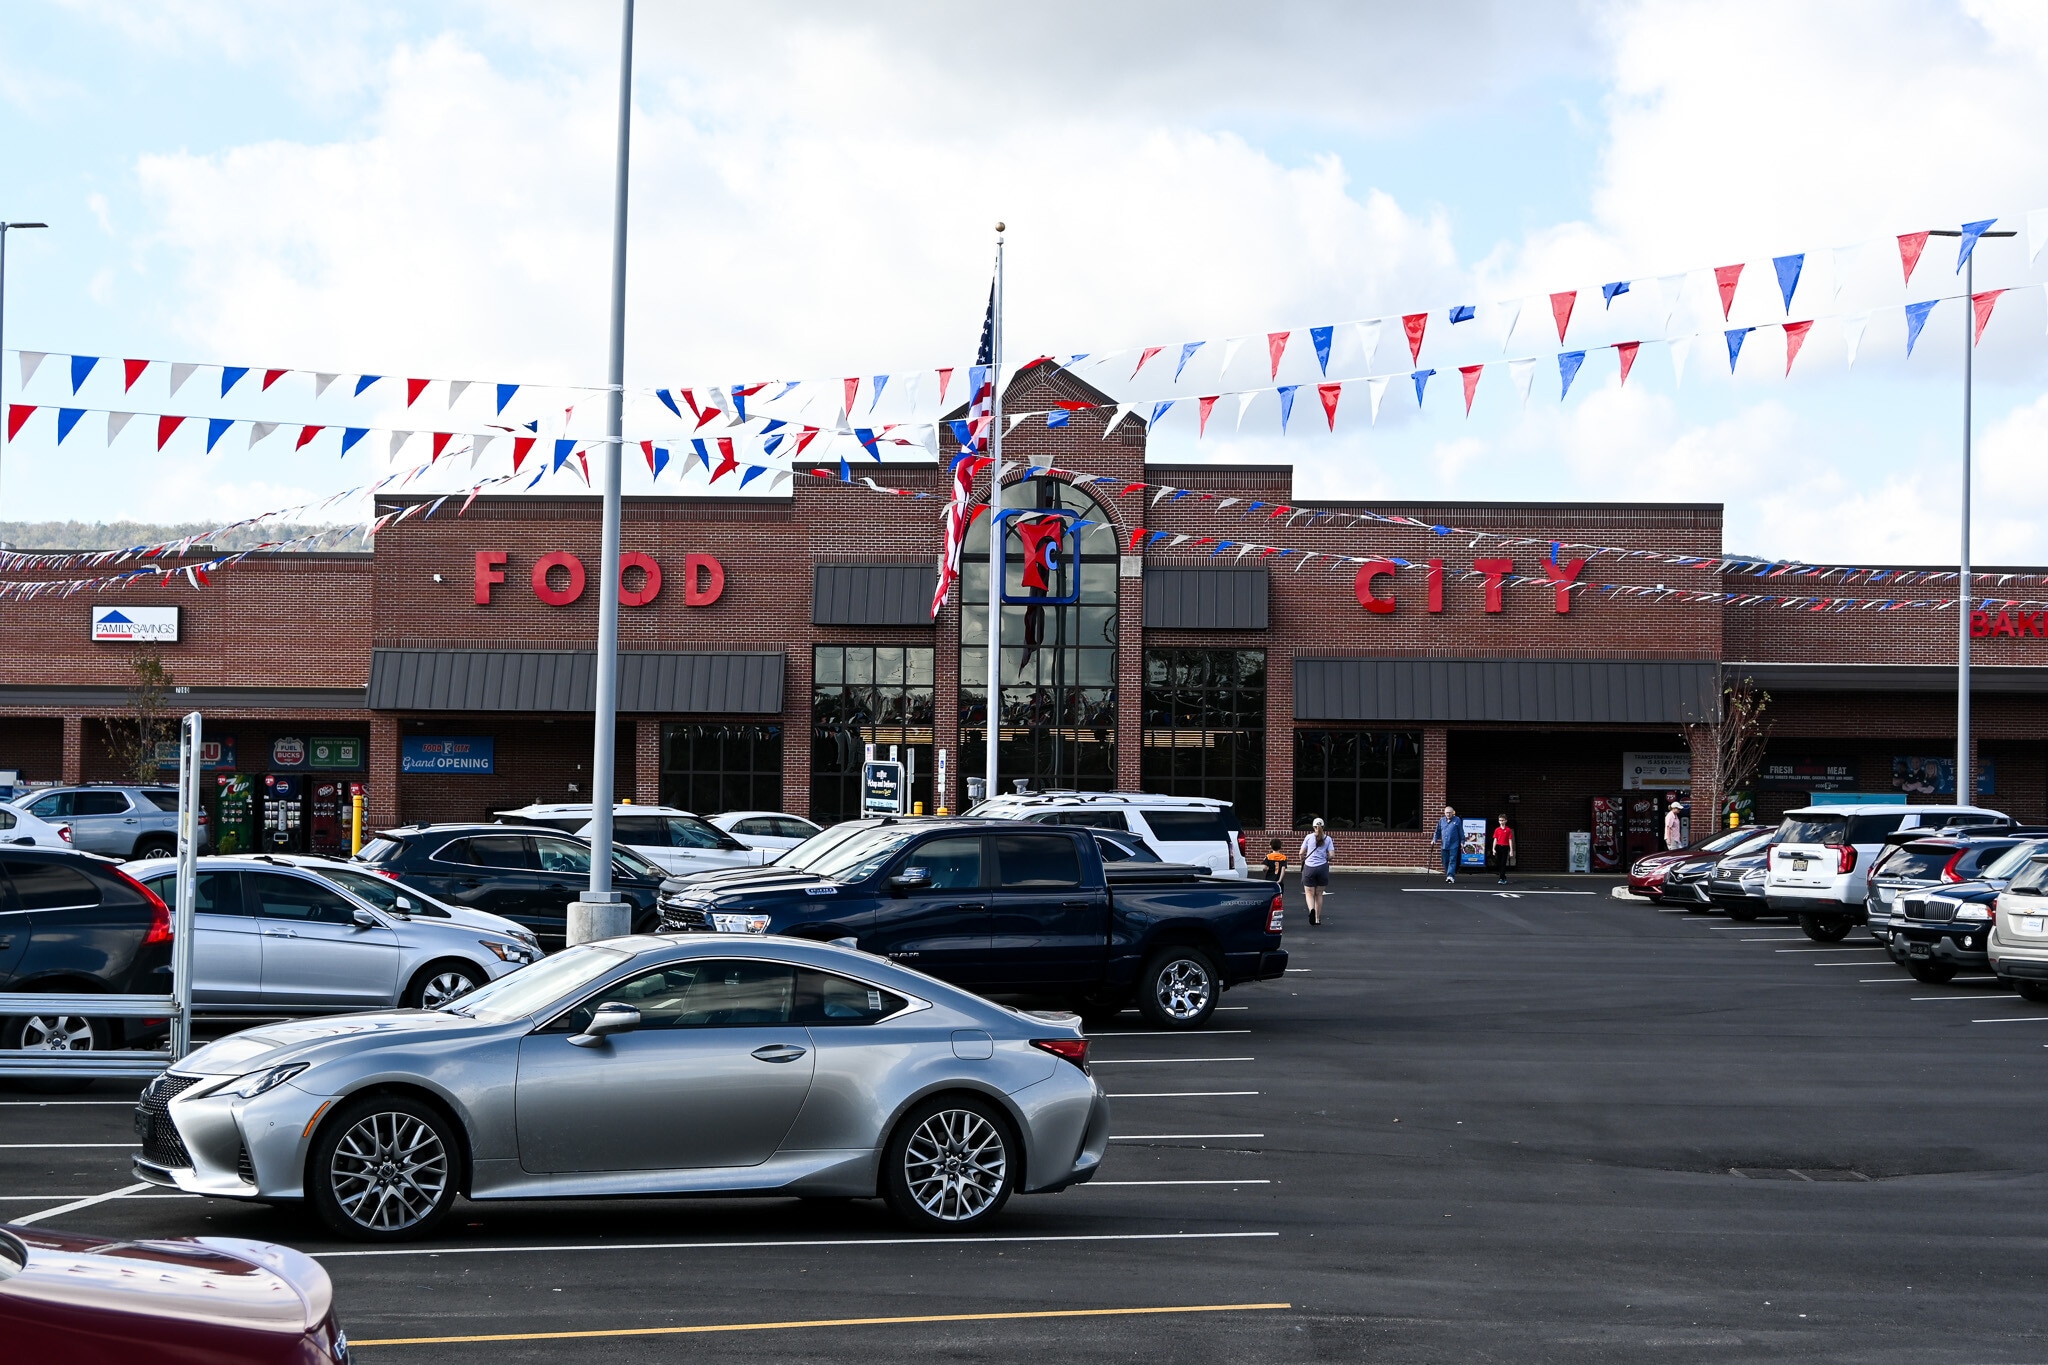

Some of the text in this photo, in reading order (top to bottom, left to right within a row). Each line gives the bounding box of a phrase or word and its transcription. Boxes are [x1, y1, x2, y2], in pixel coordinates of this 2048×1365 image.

[475, 551, 725, 606] FOOD
[1355, 559, 1587, 613] CITY
[1969, 610, 2048, 638] BAK
[422, 744, 470, 752] FOOD CITY
[402, 757, 489, 770] Grand OPENING
[1769, 765, 1793, 774] FRESH
[1827, 766, 1847, 775] MEAT
[883, 781, 897, 790] Delivery
[669, 920, 688, 929] RAM
